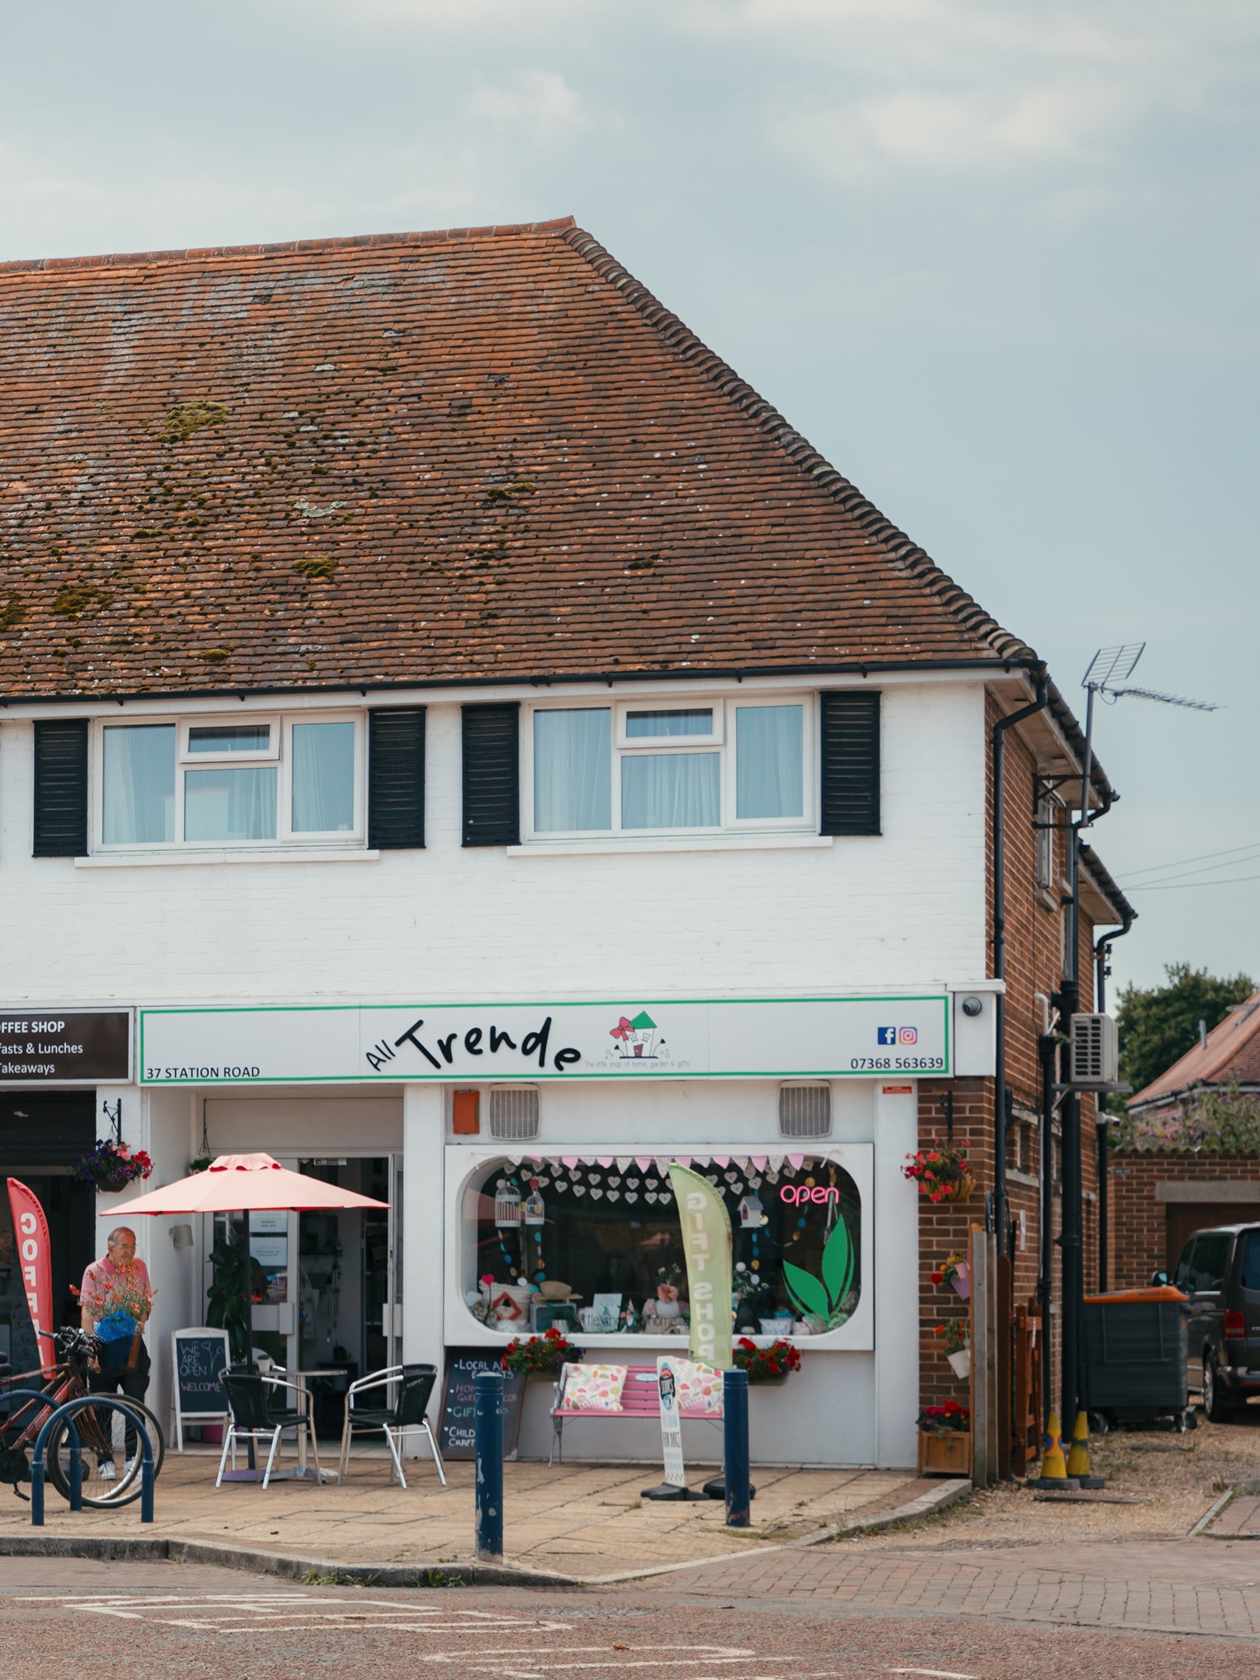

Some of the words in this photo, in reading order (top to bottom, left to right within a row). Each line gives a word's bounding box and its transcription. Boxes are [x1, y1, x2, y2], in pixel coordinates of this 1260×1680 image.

[31, 1020, 65, 1033] SHOP
[25, 1042, 35, 1054] &
[38, 1042, 84, 1054] Lunches
[394, 1016, 581, 1072] Trende
[365, 1039, 396, 1072] All
[850, 1058, 891, 1069] 07368
[895, 1057, 944, 1069] 563639
[147, 1068, 161, 1079] 37
[165, 1067, 219, 1078] STATION
[223, 1066, 260, 1077] ROAD
[780, 1184, 839, 1207] open
[180, 1341, 200, 1355] WE
[181, 1355, 200, 1366] ARE
[459, 1359, 489, 1371] LOCAL
[180, 1365, 207, 1376] OPEN
[180, 1381, 222, 1392] WELCOME
